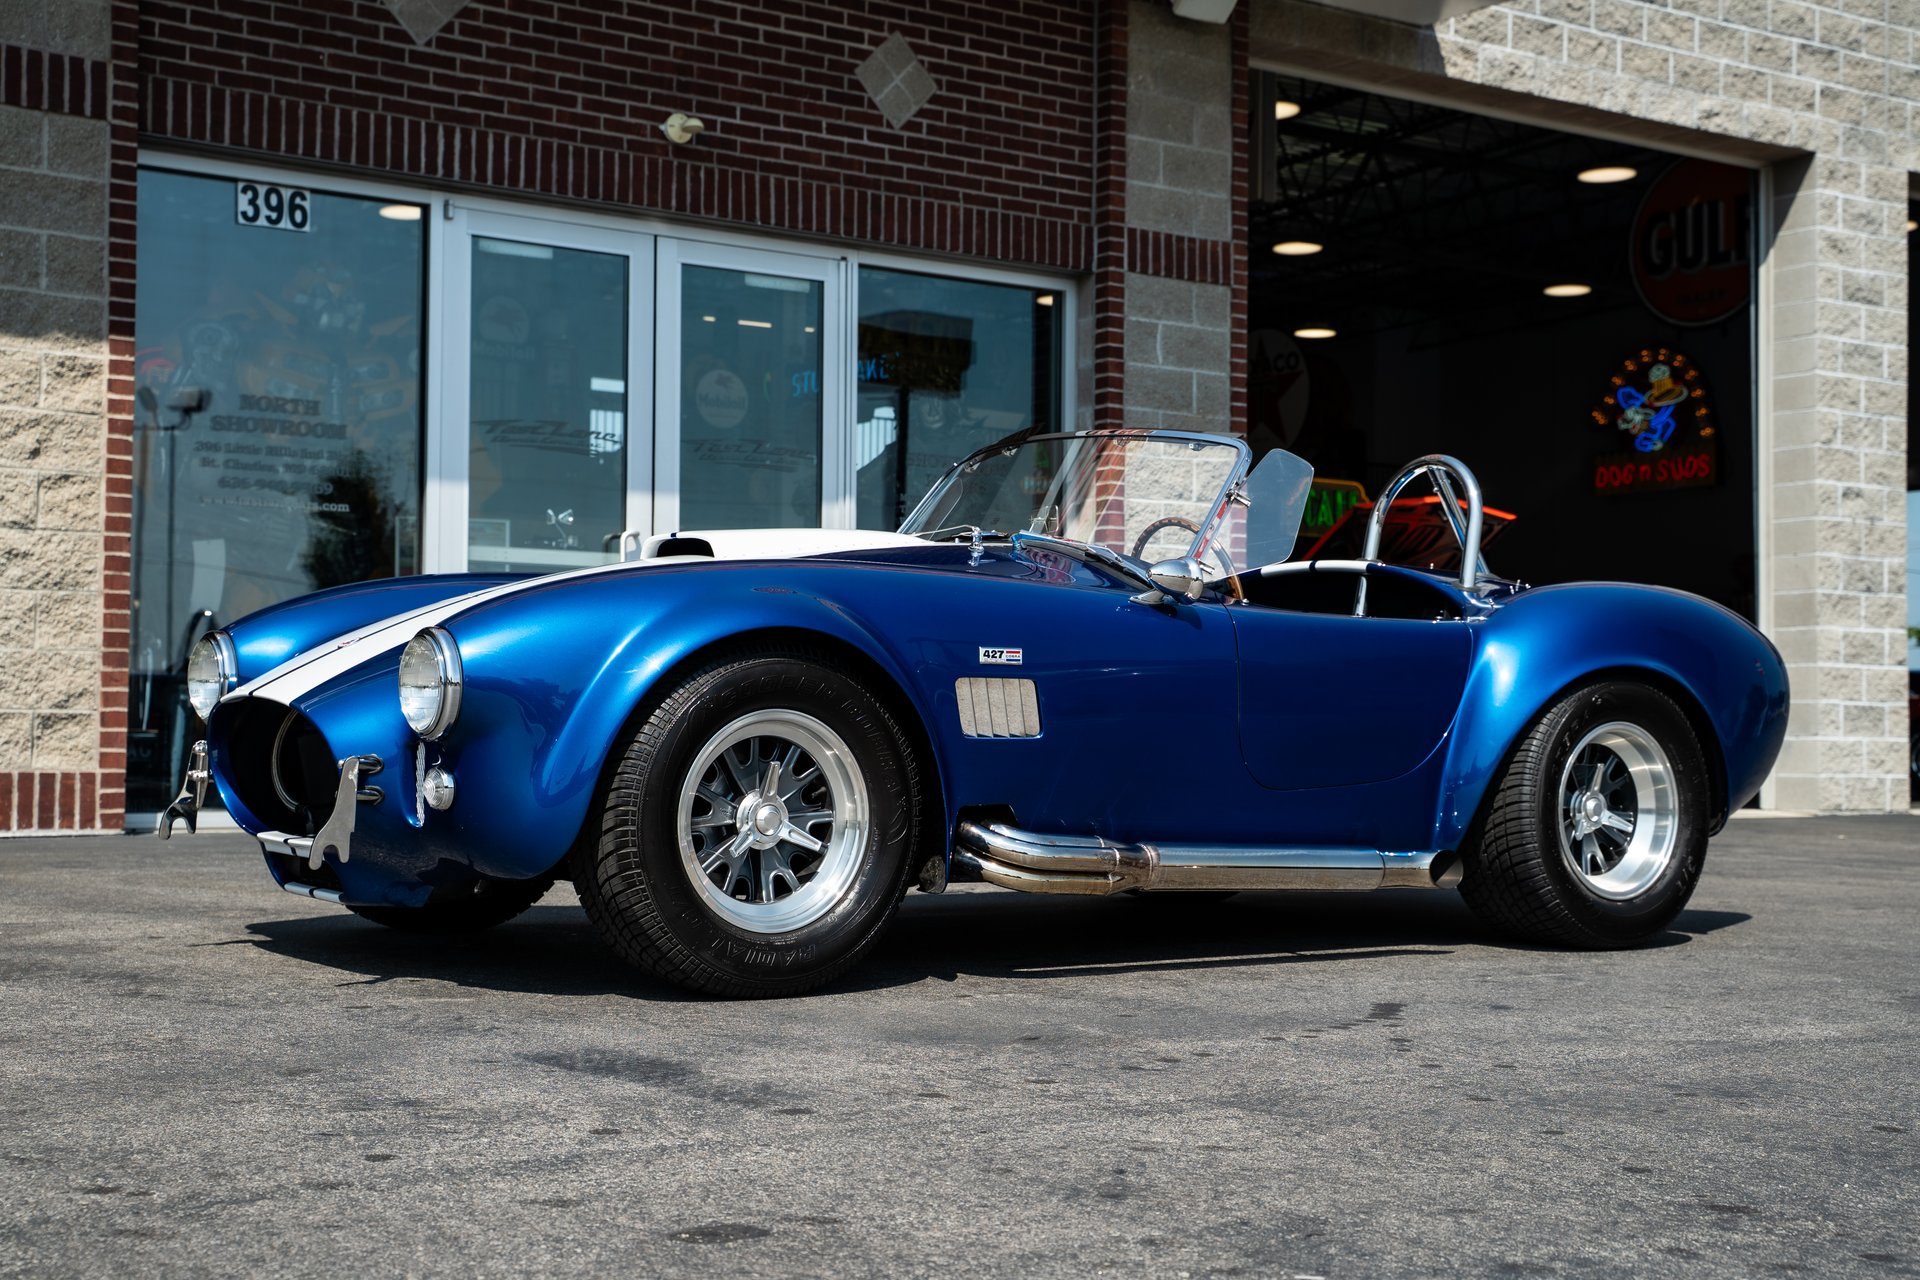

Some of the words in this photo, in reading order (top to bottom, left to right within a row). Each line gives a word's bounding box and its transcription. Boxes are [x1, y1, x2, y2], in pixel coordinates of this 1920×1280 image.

[240, 183, 308, 229] 396
[238, 394, 321, 416] NORTH
[210, 415, 348, 440] SHOWROOM
[1595, 463, 1636, 488] DOG
[1656, 453, 1711, 482] SUDS
[983, 649, 1004, 659] 427
[721, 674, 836, 709] COOPER
